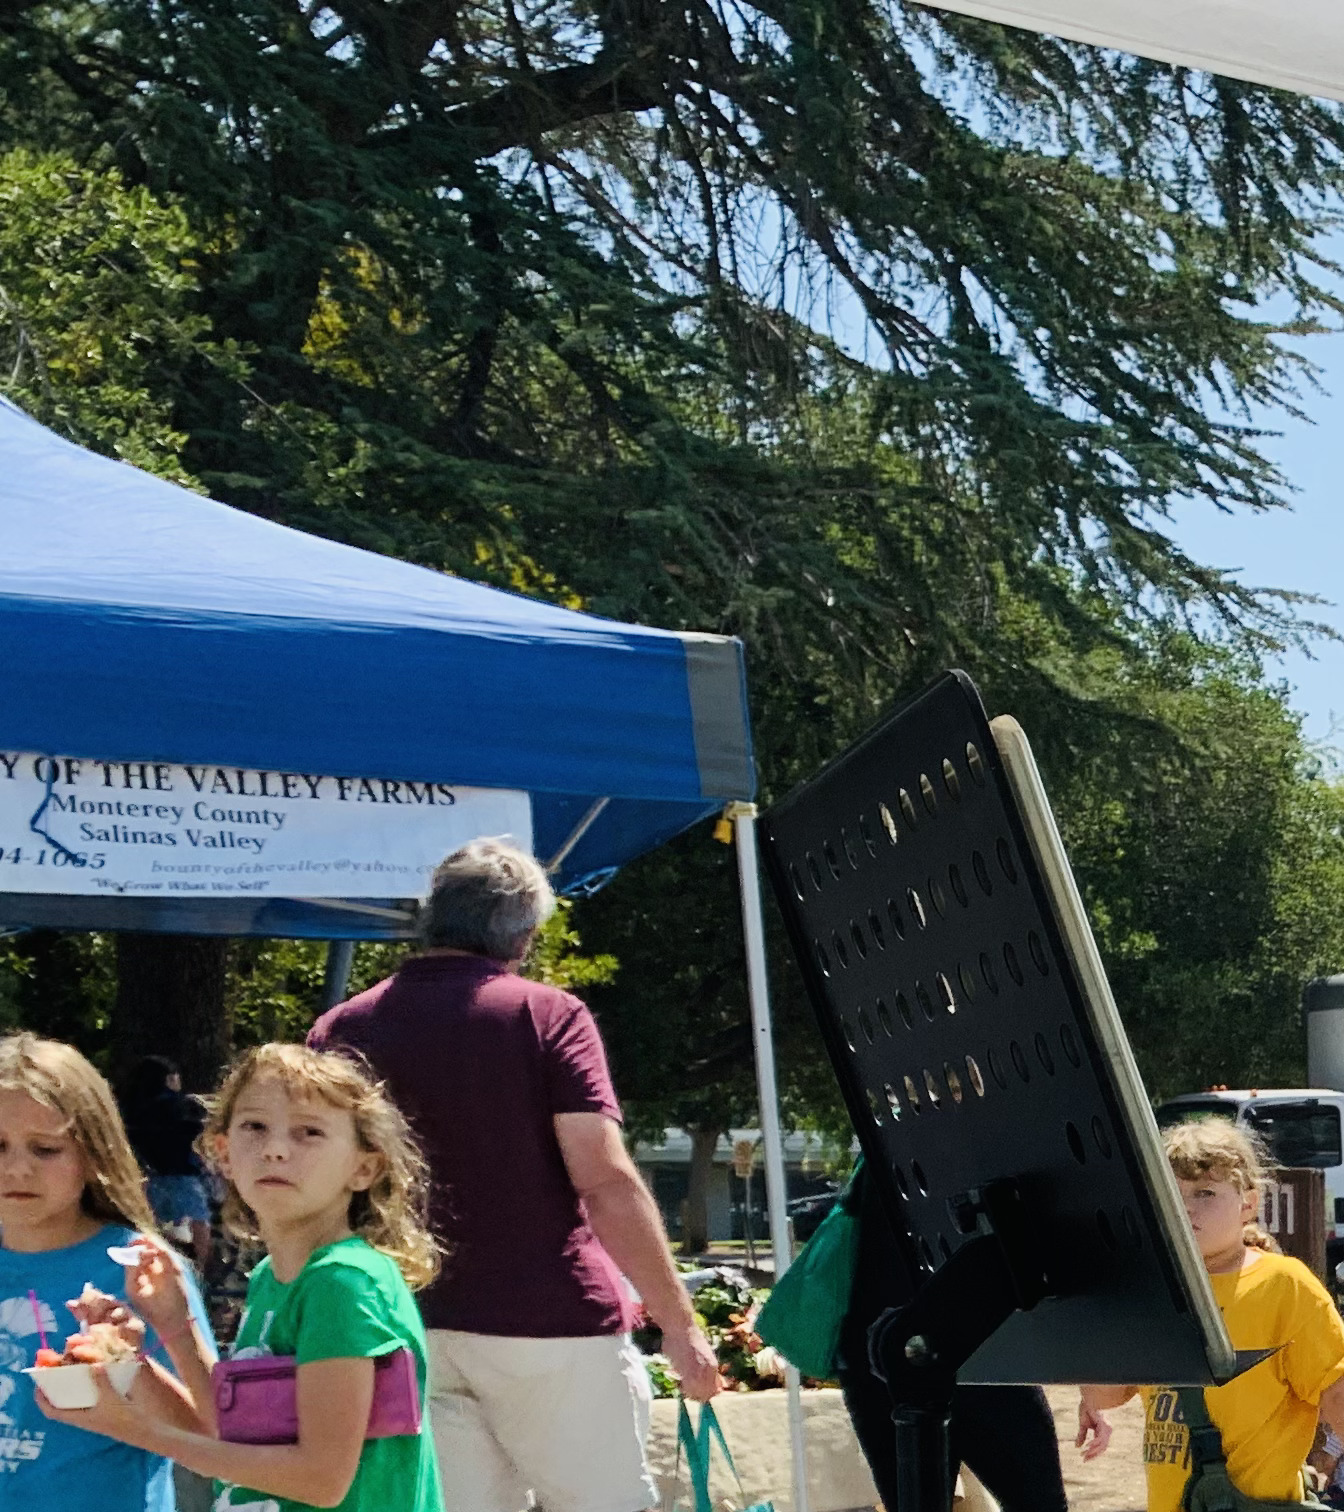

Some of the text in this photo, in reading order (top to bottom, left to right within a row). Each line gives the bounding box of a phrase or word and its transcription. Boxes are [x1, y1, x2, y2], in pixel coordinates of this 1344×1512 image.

[34, 757, 83, 785] OF
[94, 760, 174, 792] THE
[184, 765, 323, 799] VALLEY
[334, 776, 456, 806] FARMS
[51, 793, 287, 830] Monterey County
[80, 822, 267, 855] Salinas Valley
[0, 846, 106, 869] 4-1065
